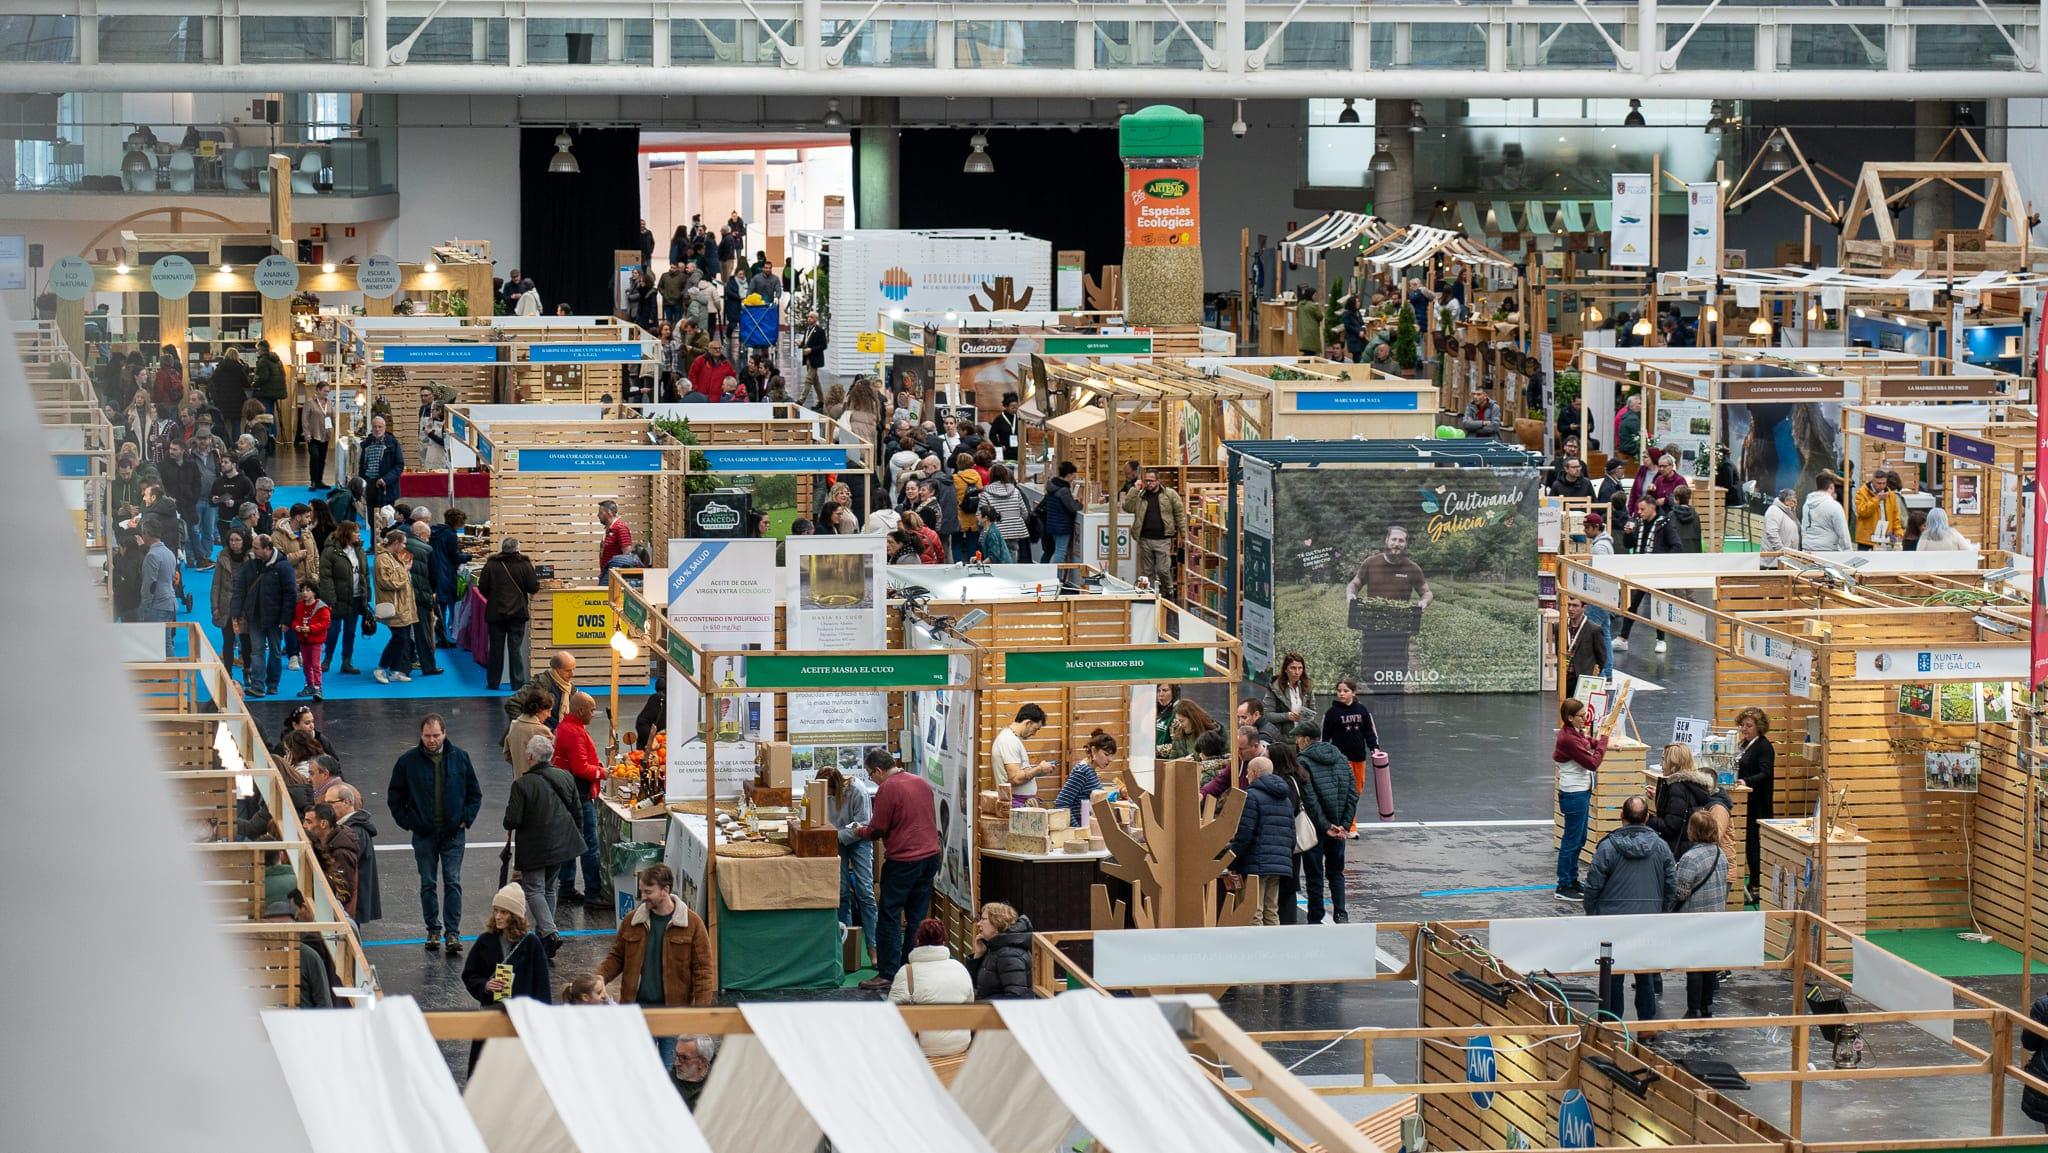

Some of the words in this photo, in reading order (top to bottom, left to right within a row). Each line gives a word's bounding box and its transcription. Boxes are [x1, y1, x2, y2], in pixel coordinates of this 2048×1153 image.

[1149, 184, 1184, 193] ARTEMIS
[1141, 205, 1191, 218] Especias
[1137, 216, 1195, 230] Ecológicas
[961, 342, 1007, 354] Quevana
[1443, 485, 1524, 516] Cultivando
[1427, 514, 1487, 543] Galicia
[672, 575, 685, 590] 100
[683, 568, 692, 577] %
[689, 549, 710, 572] SALUD
[577, 614, 605, 628] OVOS
[576, 631, 606, 639] CHANTADA
[1934, 653, 1963, 661] XUNTA
[801, 666, 830, 674] ACEITE
[1066, 660, 1084, 668] MÁS
[1085, 660, 1128, 669] QUESEROS
[1946, 662, 1982, 670] GALICIA
[1374, 670, 1439, 682] ORBALLO
[1676, 720, 1690, 731] SEN
[1469, 1048, 1495, 1083] AMC
[1564, 1112, 1592, 1149] AMC
